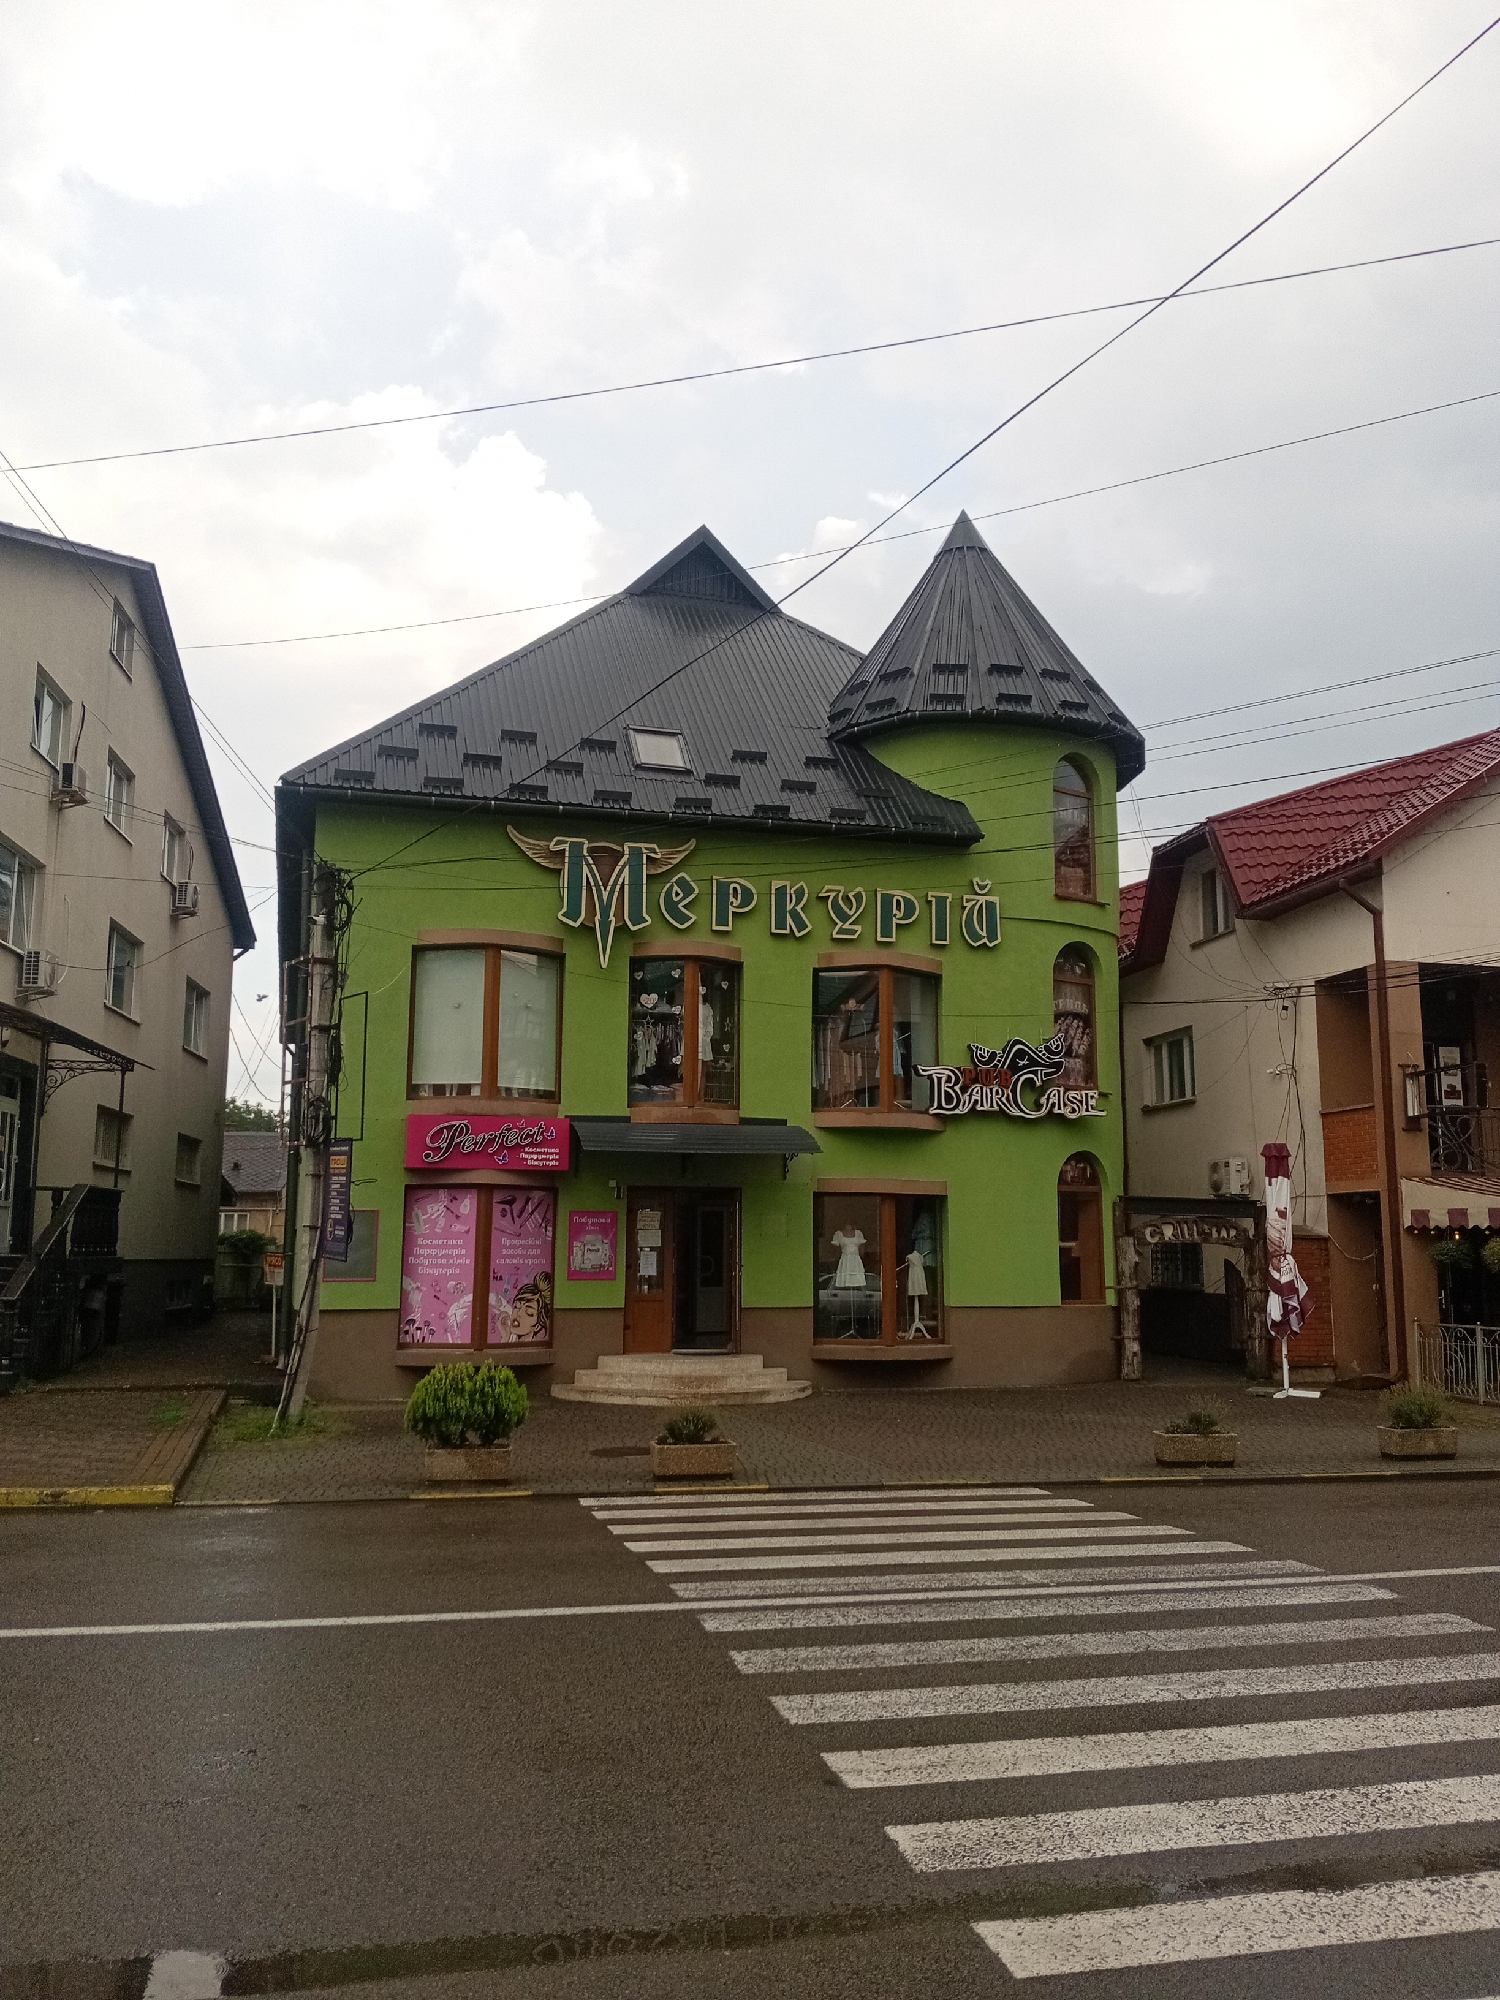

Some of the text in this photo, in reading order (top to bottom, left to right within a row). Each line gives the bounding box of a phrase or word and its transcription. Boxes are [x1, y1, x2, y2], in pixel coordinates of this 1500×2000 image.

[961, 1066, 1013, 1089] PUB
[423, 1119, 546, 1163] Perfect
[573, 1216, 611, 1225] Побутова
[417, 1237, 464, 1246] Косметика
[413, 1247, 466, 1257] Парфумерія
[408, 1257, 447, 1267] Побутова
[418, 1267, 461, 1277] Біжутерія
